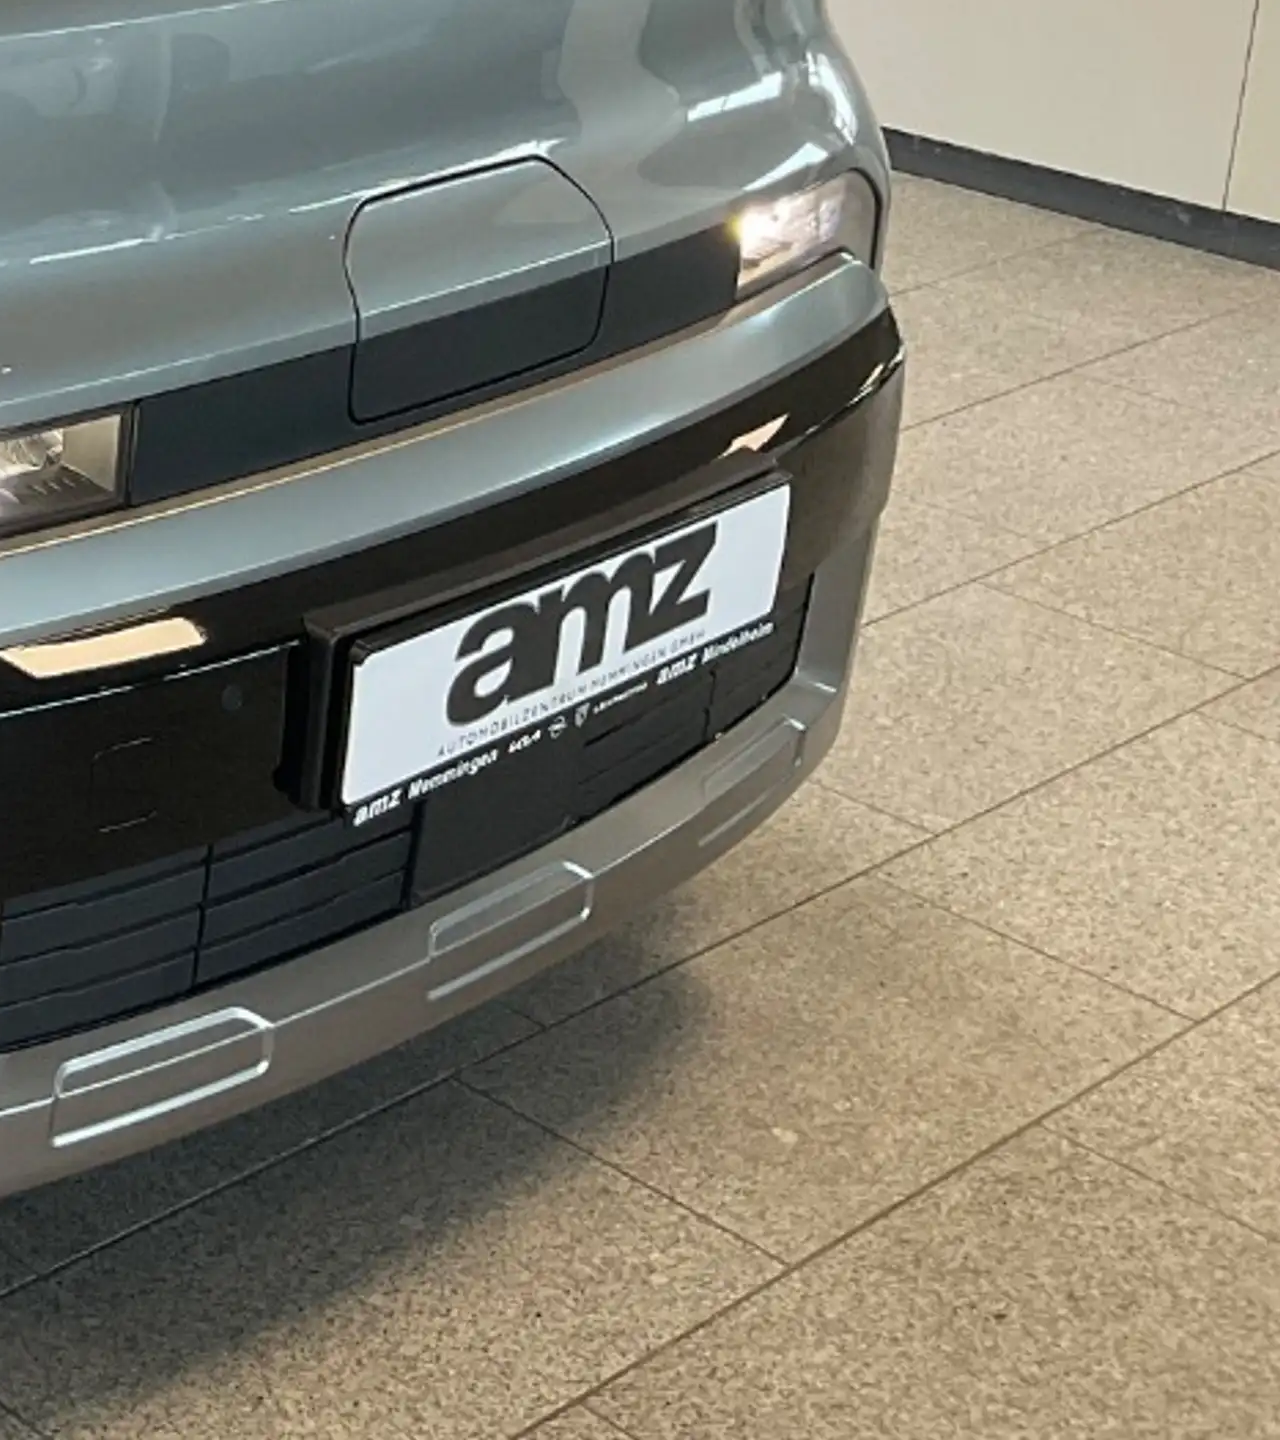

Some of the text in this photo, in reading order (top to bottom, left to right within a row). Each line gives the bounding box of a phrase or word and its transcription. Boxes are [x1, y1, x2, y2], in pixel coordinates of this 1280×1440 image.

[445, 521, 718, 725] amz
[352, 789, 403, 826] amz
[407, 749, 499, 800] Memmingen
[656, 652, 697, 685] amz
